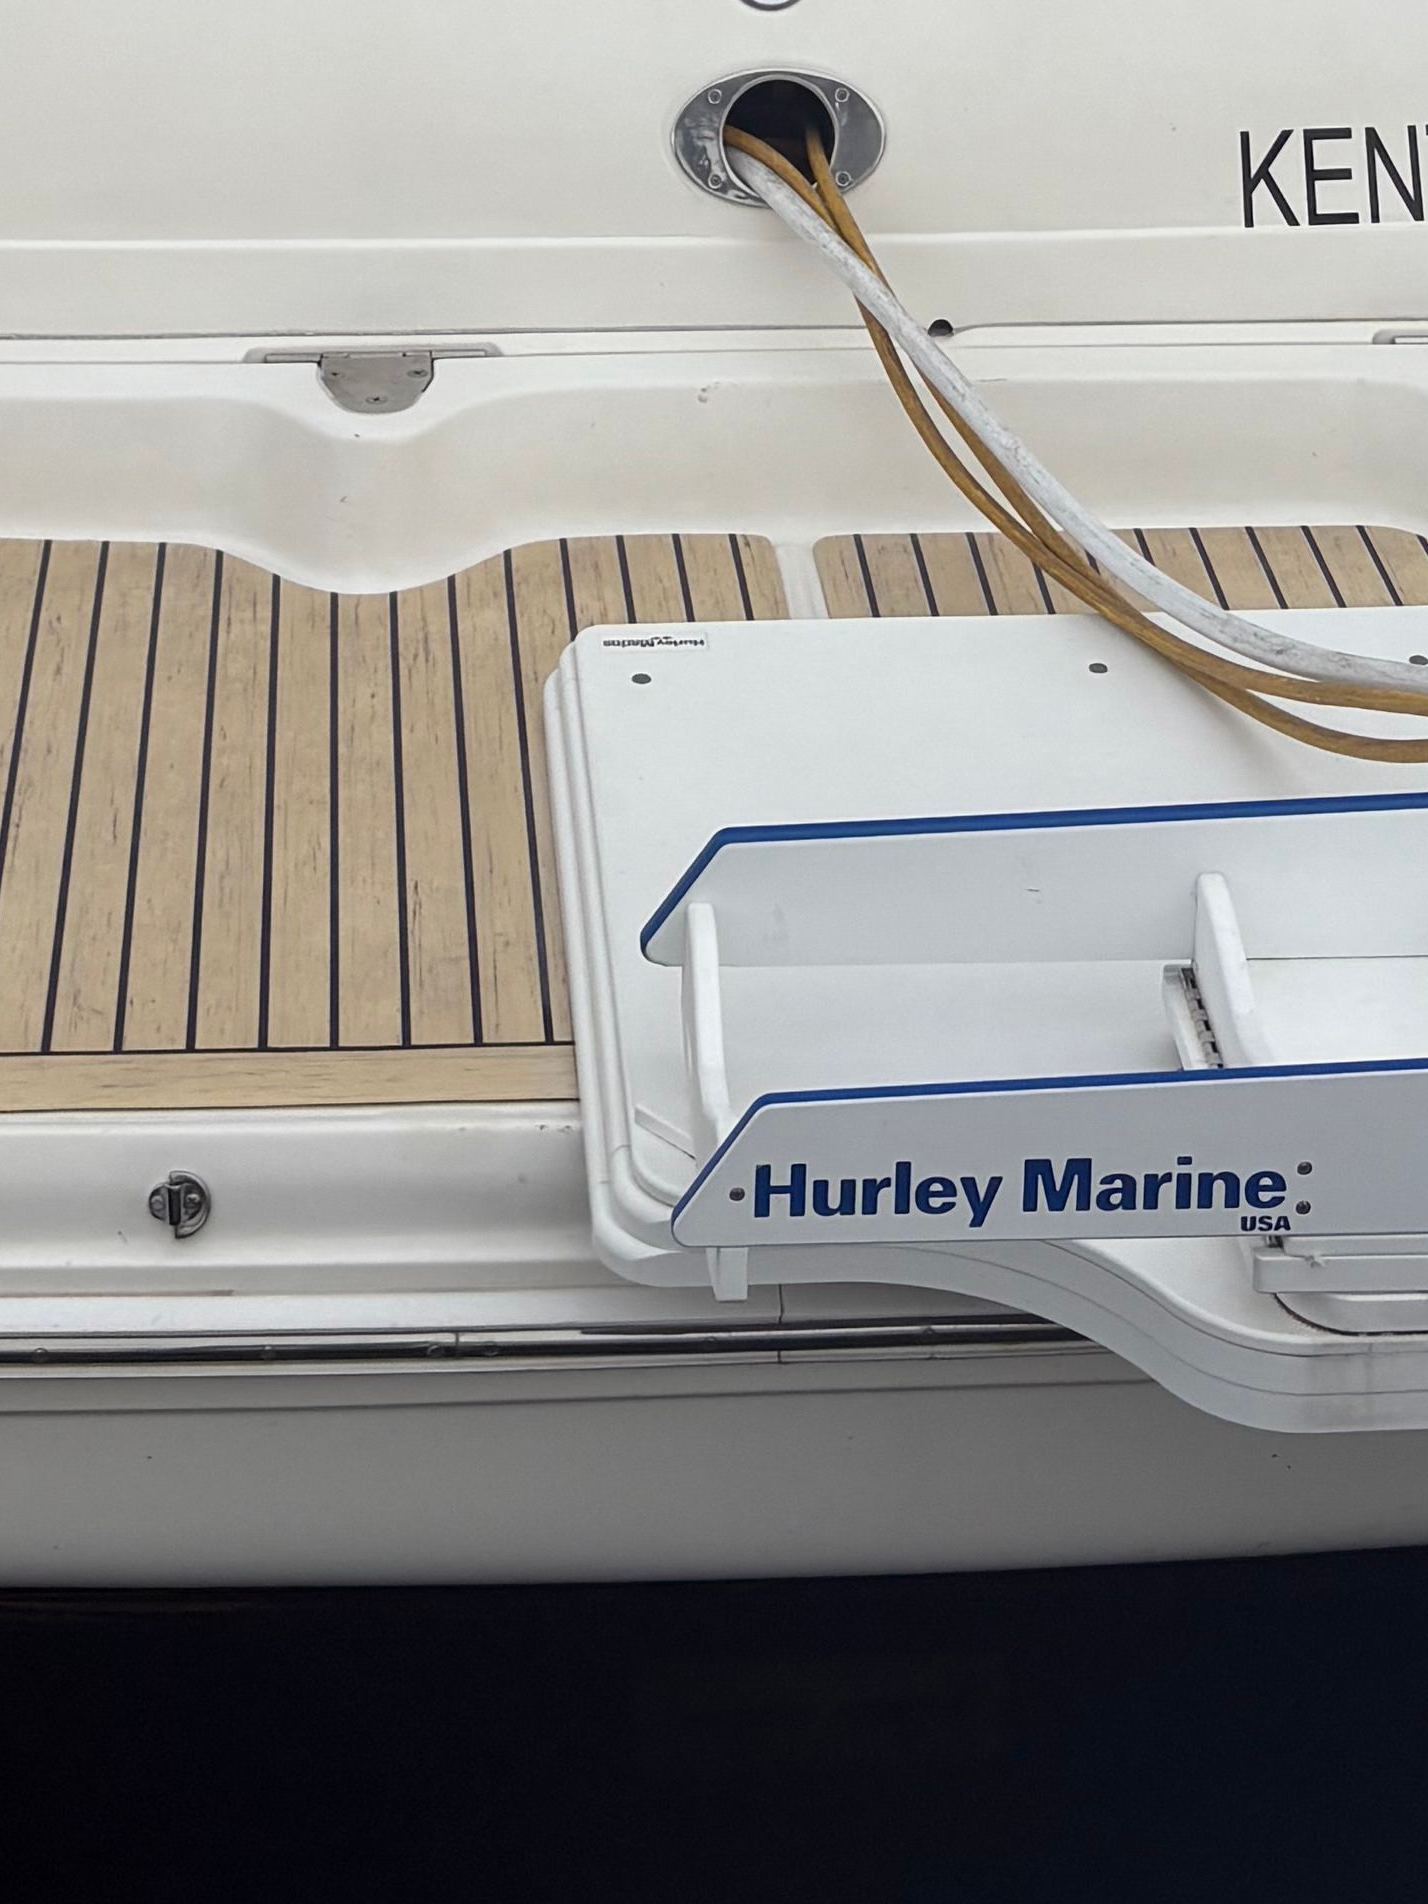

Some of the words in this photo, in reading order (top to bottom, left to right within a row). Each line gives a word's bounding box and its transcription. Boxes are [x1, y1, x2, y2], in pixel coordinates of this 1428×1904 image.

[752, 1160, 1004, 1229] Hurley
[1021, 1155, 1289, 1212] Marine
[1239, 1214, 1293, 1233] USA
